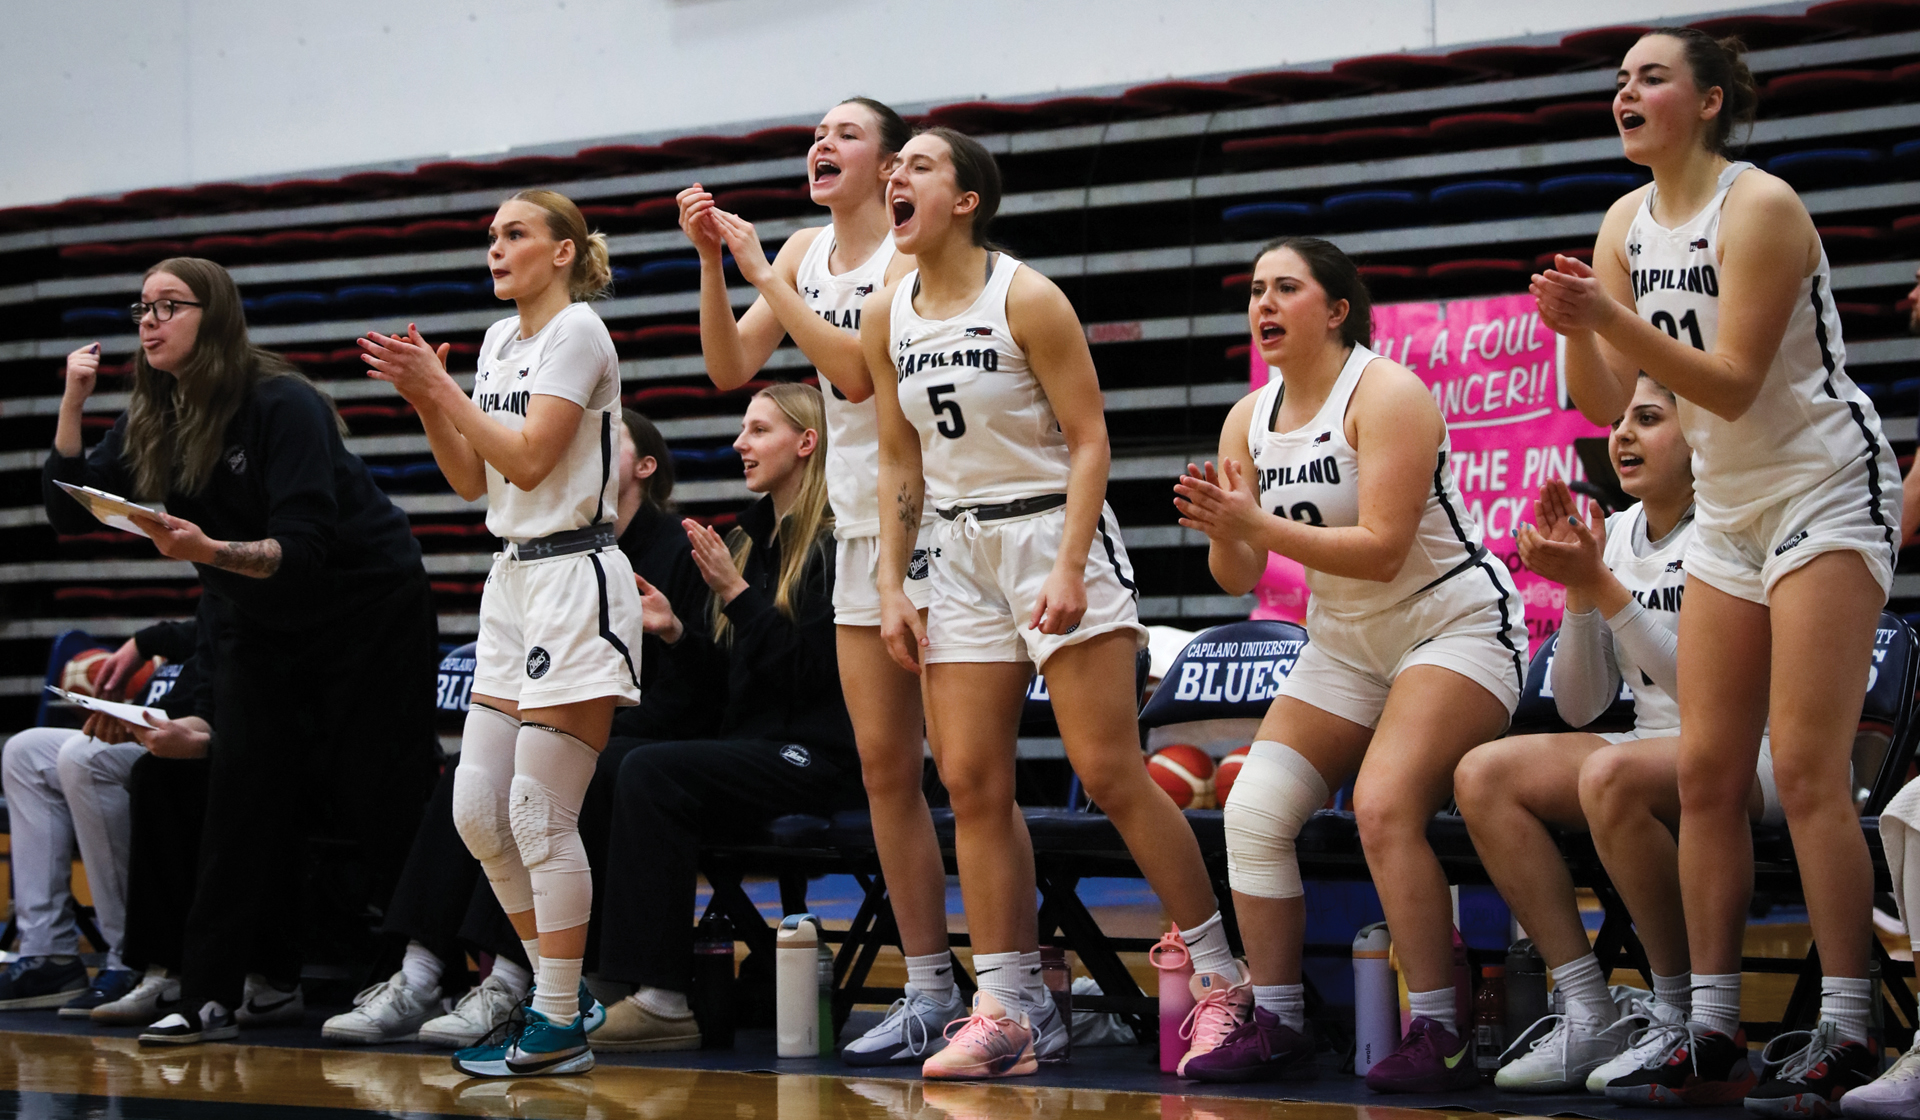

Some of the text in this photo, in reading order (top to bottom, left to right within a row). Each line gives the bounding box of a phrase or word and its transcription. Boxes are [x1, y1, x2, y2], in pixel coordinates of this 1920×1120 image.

[1631, 264, 1719, 302] CAPILANO
[1430, 328, 1448, 370] A
[1460, 312, 1544, 364] FOUL
[897, 348, 998, 384] CAPILANO
[926, 383, 967, 439] 5
[1430, 360, 1550, 419] ANCER!!
[1451, 449, 1509, 491] THE
[1466, 496, 1528, 541] ACY
[1187, 640, 1305, 658] CAPILANO UNIVERSITY
[437, 673, 474, 711] BLU
[1174, 658, 1295, 703] BLUES
